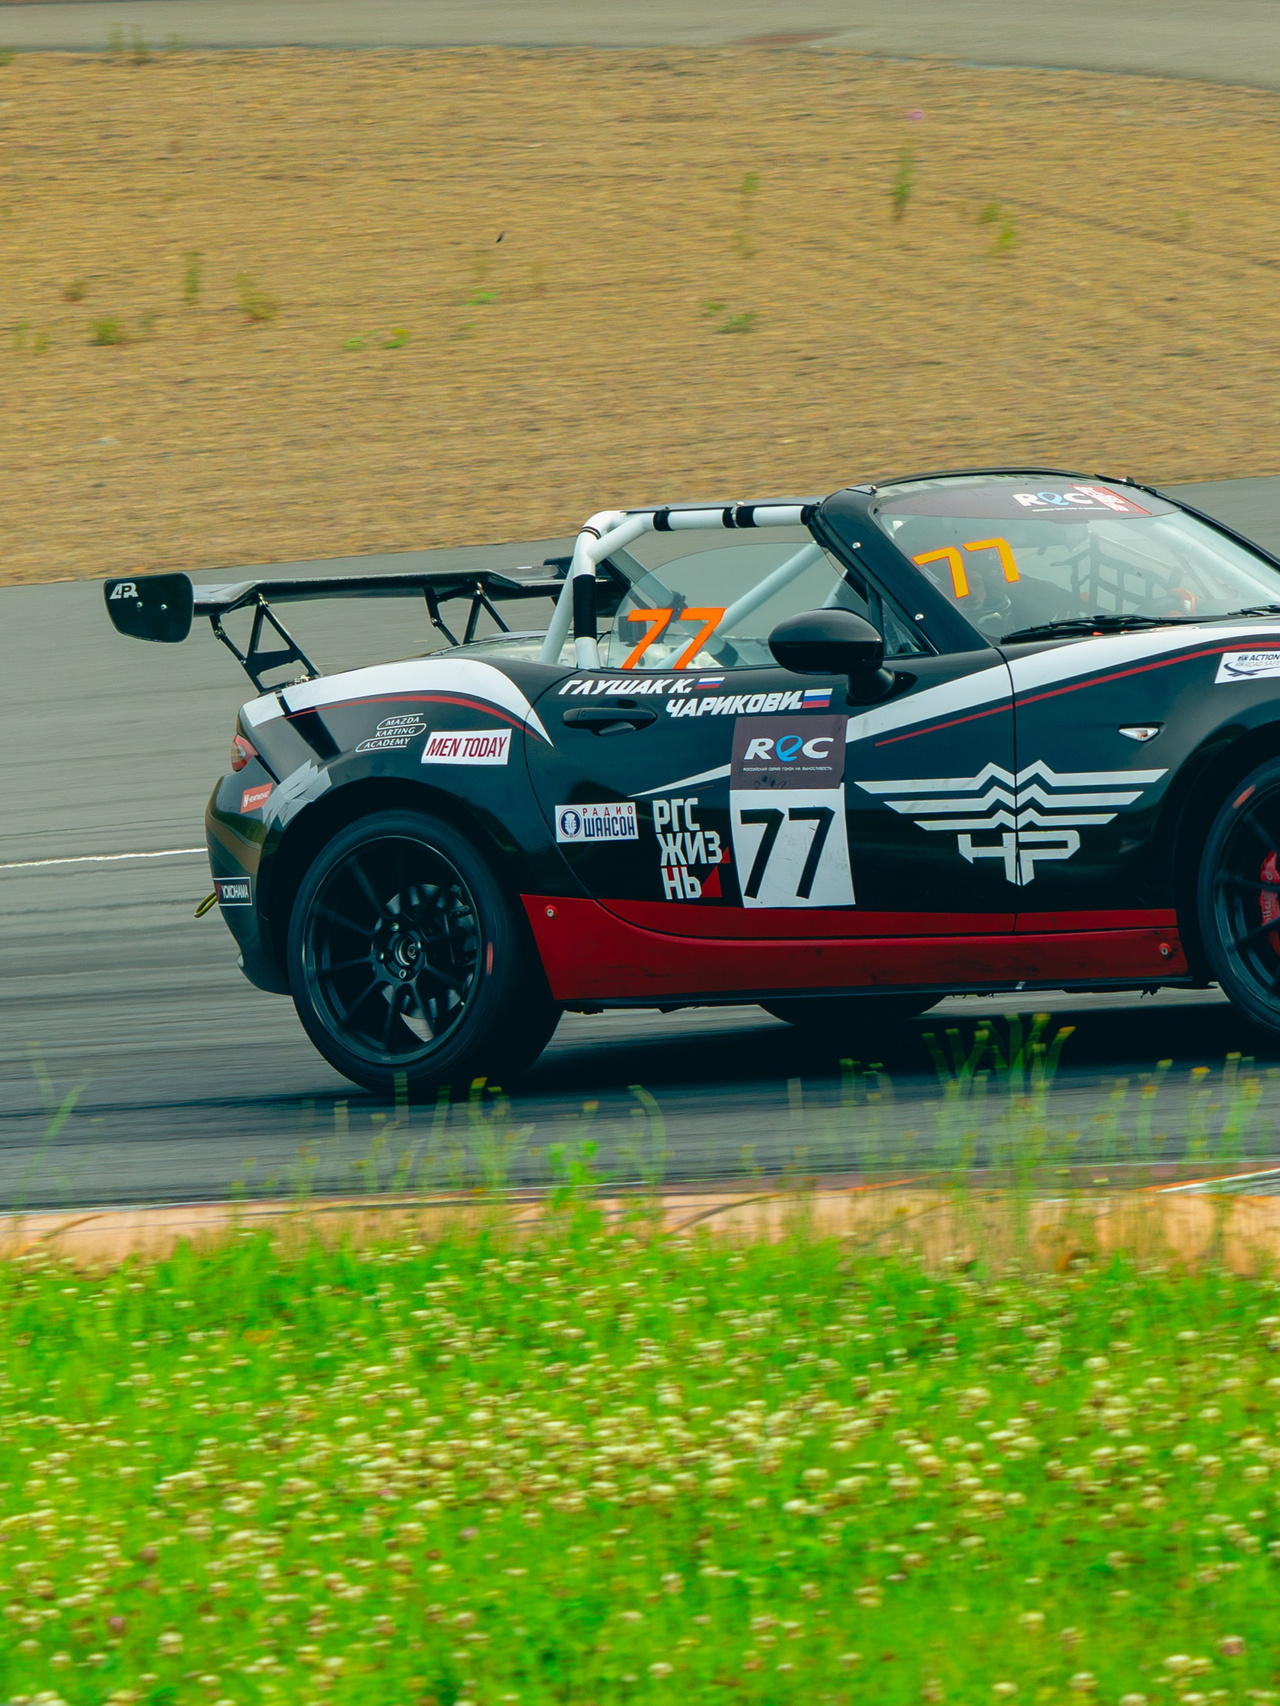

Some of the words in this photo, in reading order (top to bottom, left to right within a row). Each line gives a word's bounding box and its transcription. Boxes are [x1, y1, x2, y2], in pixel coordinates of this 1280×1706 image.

[911, 537, 1020, 599] 77
[621, 607, 726, 670] 77
[1249, 653, 1280, 661] ACTION
[558, 679, 672, 696] ГЛУШАК
[375, 727, 416, 738] KARTING
[385, 716, 420, 727] MAZDA
[364, 737, 411, 749] ACADEMY
[426, 738, 461, 757] MEN
[462, 736, 508, 758] TODAY
[582, 805, 633, 817] РАДИО
[652, 798, 700, 832] РГС
[583, 816, 636, 838] ШАНСОН
[656, 831, 723, 866] ЖИЗ
[740, 806, 836, 899] 77
[661, 866, 702, 900] НЬ
